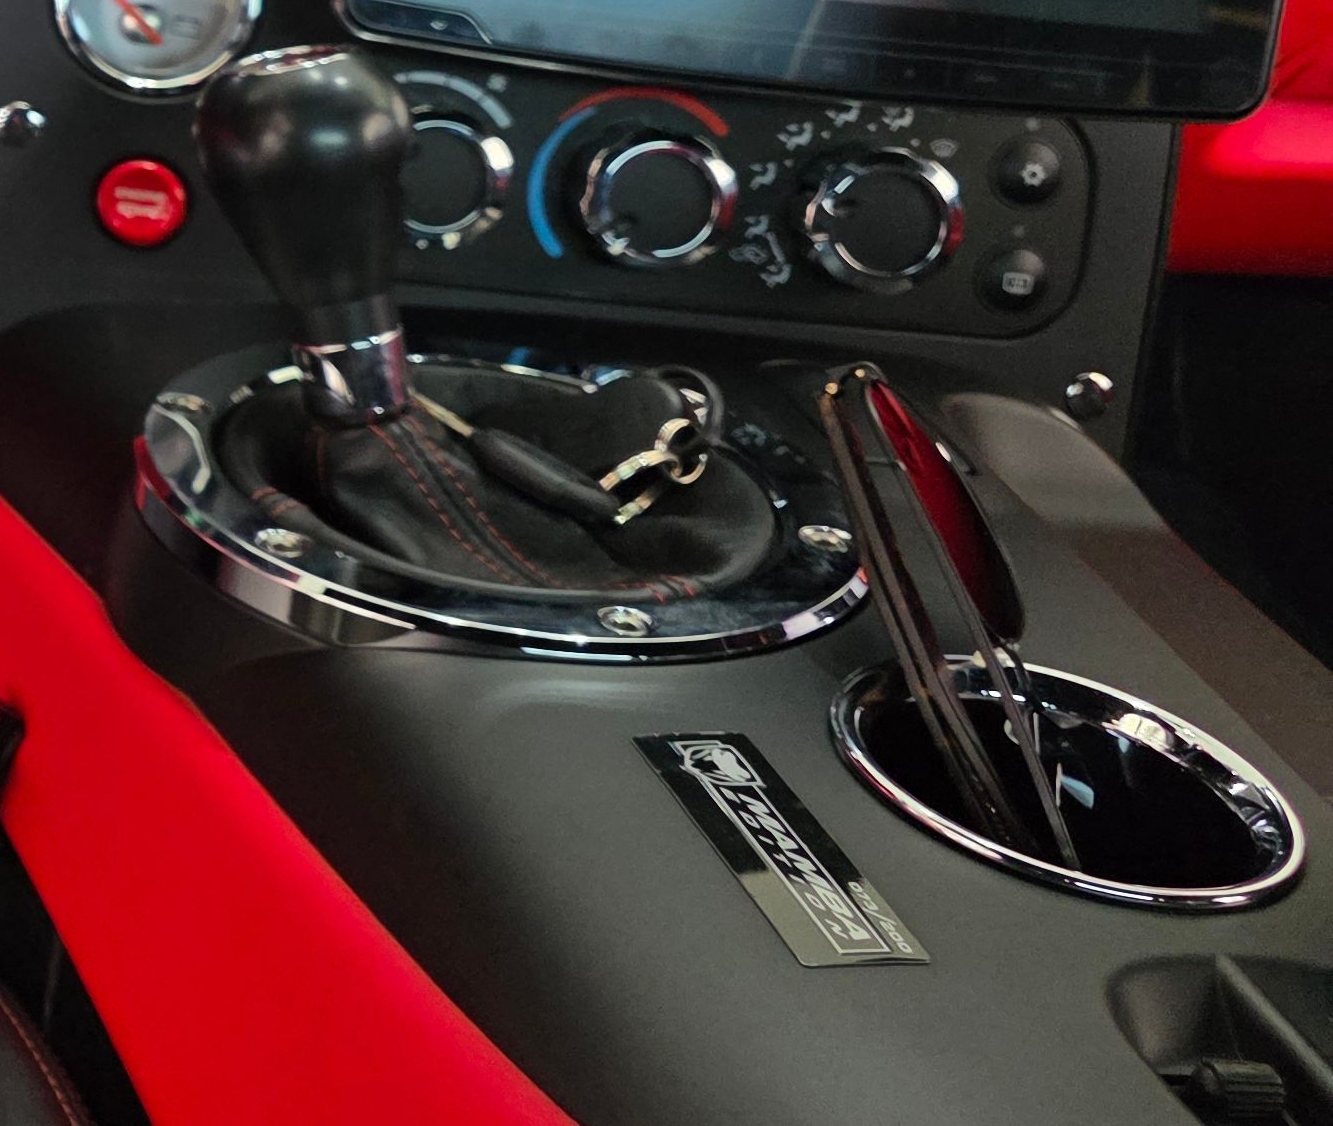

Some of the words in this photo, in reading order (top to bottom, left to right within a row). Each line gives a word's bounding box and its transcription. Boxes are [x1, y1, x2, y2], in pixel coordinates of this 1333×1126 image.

[719, 787, 849, 940] EDITION
[737, 792, 872, 941] MAMBA
[847, 881, 913, 955] 073/200
